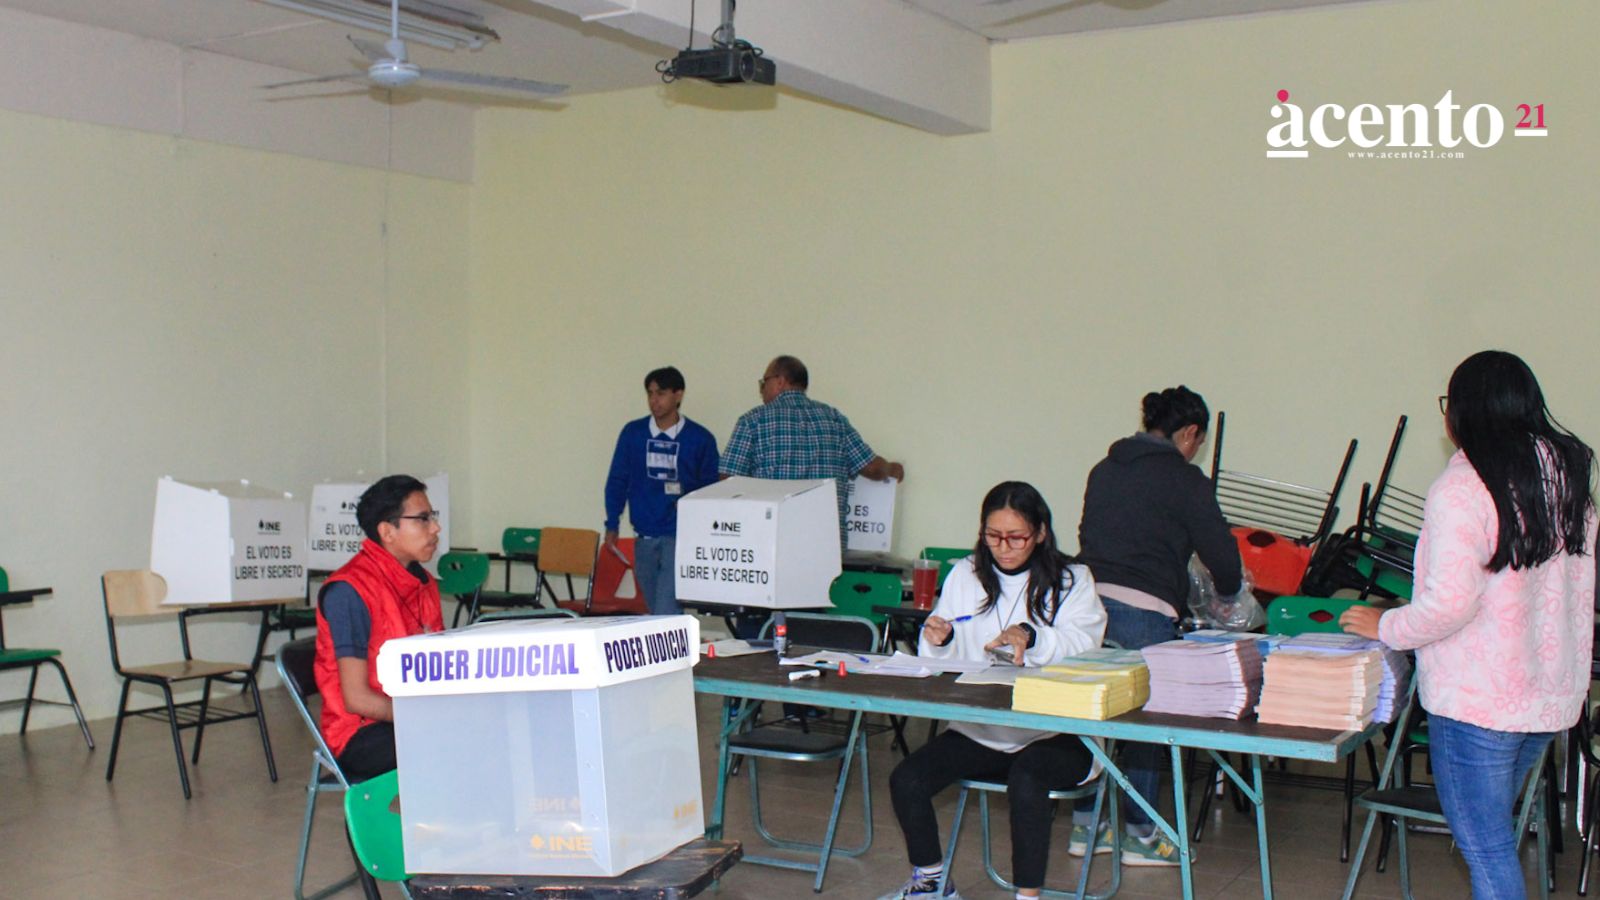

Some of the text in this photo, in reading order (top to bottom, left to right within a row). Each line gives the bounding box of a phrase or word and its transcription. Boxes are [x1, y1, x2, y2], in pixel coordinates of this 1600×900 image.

[854, 504, 870, 517] ES
[265, 521, 281, 531] INE
[326, 522, 337, 536] EL
[721, 521, 741, 533] INE
[846, 519, 886, 535] CRETO
[246, 545, 292, 560] EL VOTO ES
[311, 539, 337, 553] LIBRE
[339, 540, 345, 552] Y
[695, 546, 755, 564] EL VOTO ES
[234, 564, 303, 580] LIBRE Y SECRETO
[680, 564, 769, 586] LIBRE Y SECRETO
[604, 636, 647, 674] PODER
[401, 643, 580, 684] PODER JUDICIAL
[549, 832, 593, 852] INE
